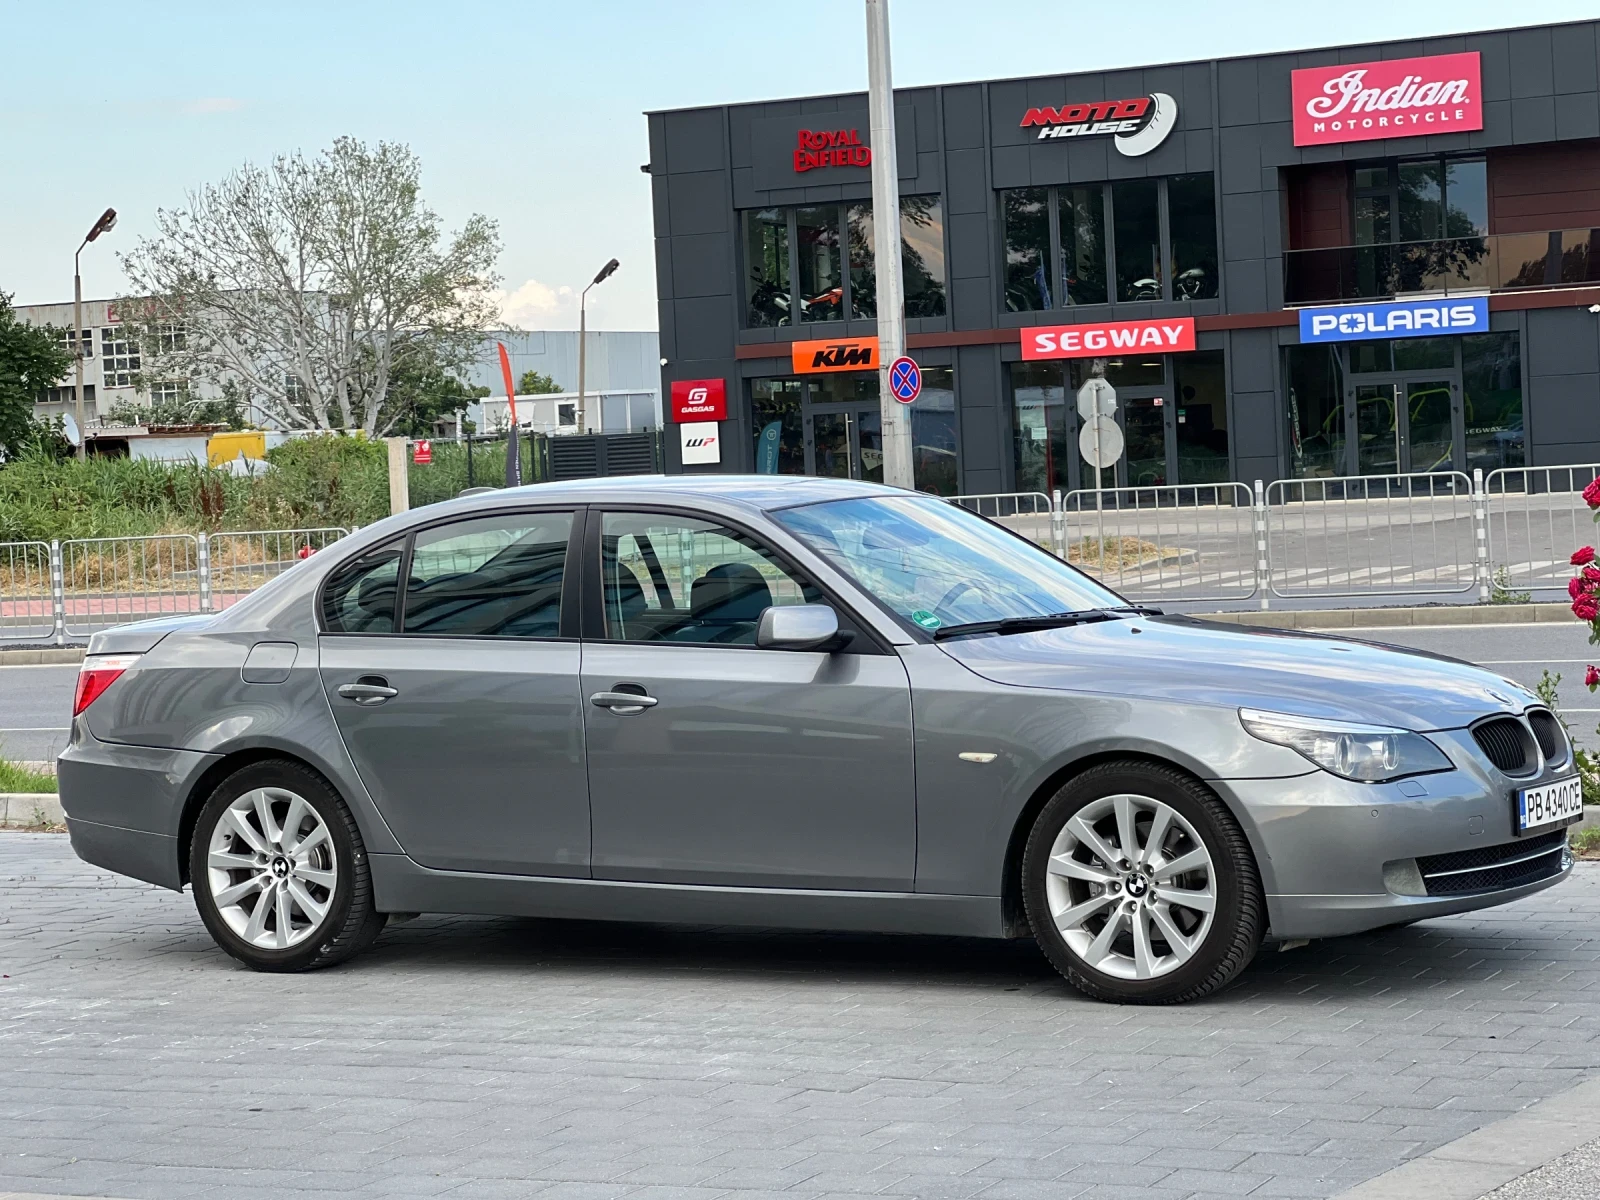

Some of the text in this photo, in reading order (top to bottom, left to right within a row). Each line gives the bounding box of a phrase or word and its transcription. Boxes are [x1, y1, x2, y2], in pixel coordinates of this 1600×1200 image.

[1020, 98, 1150, 127] MOTO
[1314, 109, 1464, 133] MOTORCYCLE
[798, 129, 862, 151] ROYAL
[1038, 119, 1141, 139] HOUSE
[793, 147, 872, 172] ENFIELD
[1312, 305, 1477, 336] POLARIS
[1035, 325, 1184, 353] SEGWAY
[812, 344, 872, 368] KTM
[681, 405, 715, 414] GASGAS
[685, 437, 716, 448] WP
[1527, 781, 1581, 823] PB 4340 CE
